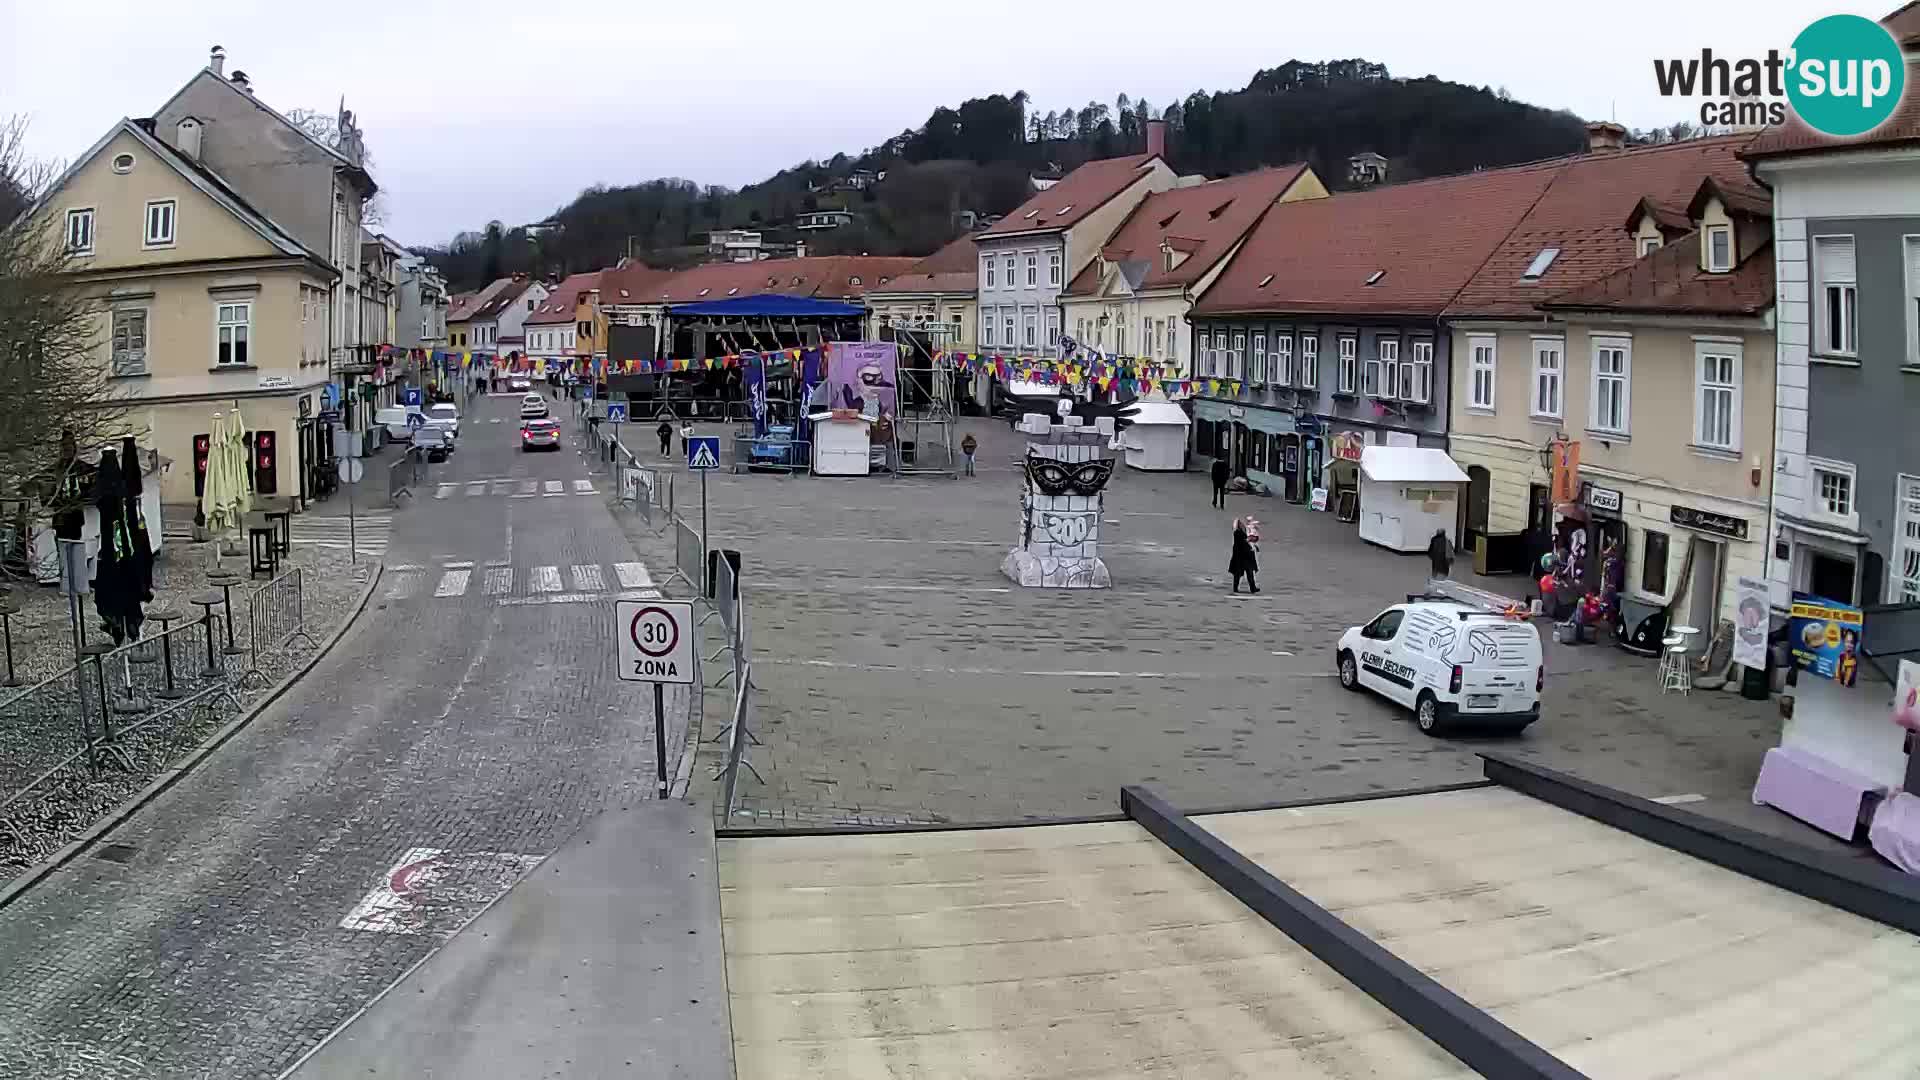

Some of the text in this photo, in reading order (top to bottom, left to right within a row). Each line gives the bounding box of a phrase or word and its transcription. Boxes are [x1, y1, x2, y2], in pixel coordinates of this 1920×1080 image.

[409, 391, 417, 403] P
[1047, 516, 1087, 546] 200
[643, 622, 667, 643] 30
[634, 660, 678, 676] ZONA
[1383, 659, 1417, 680] SECURITY
